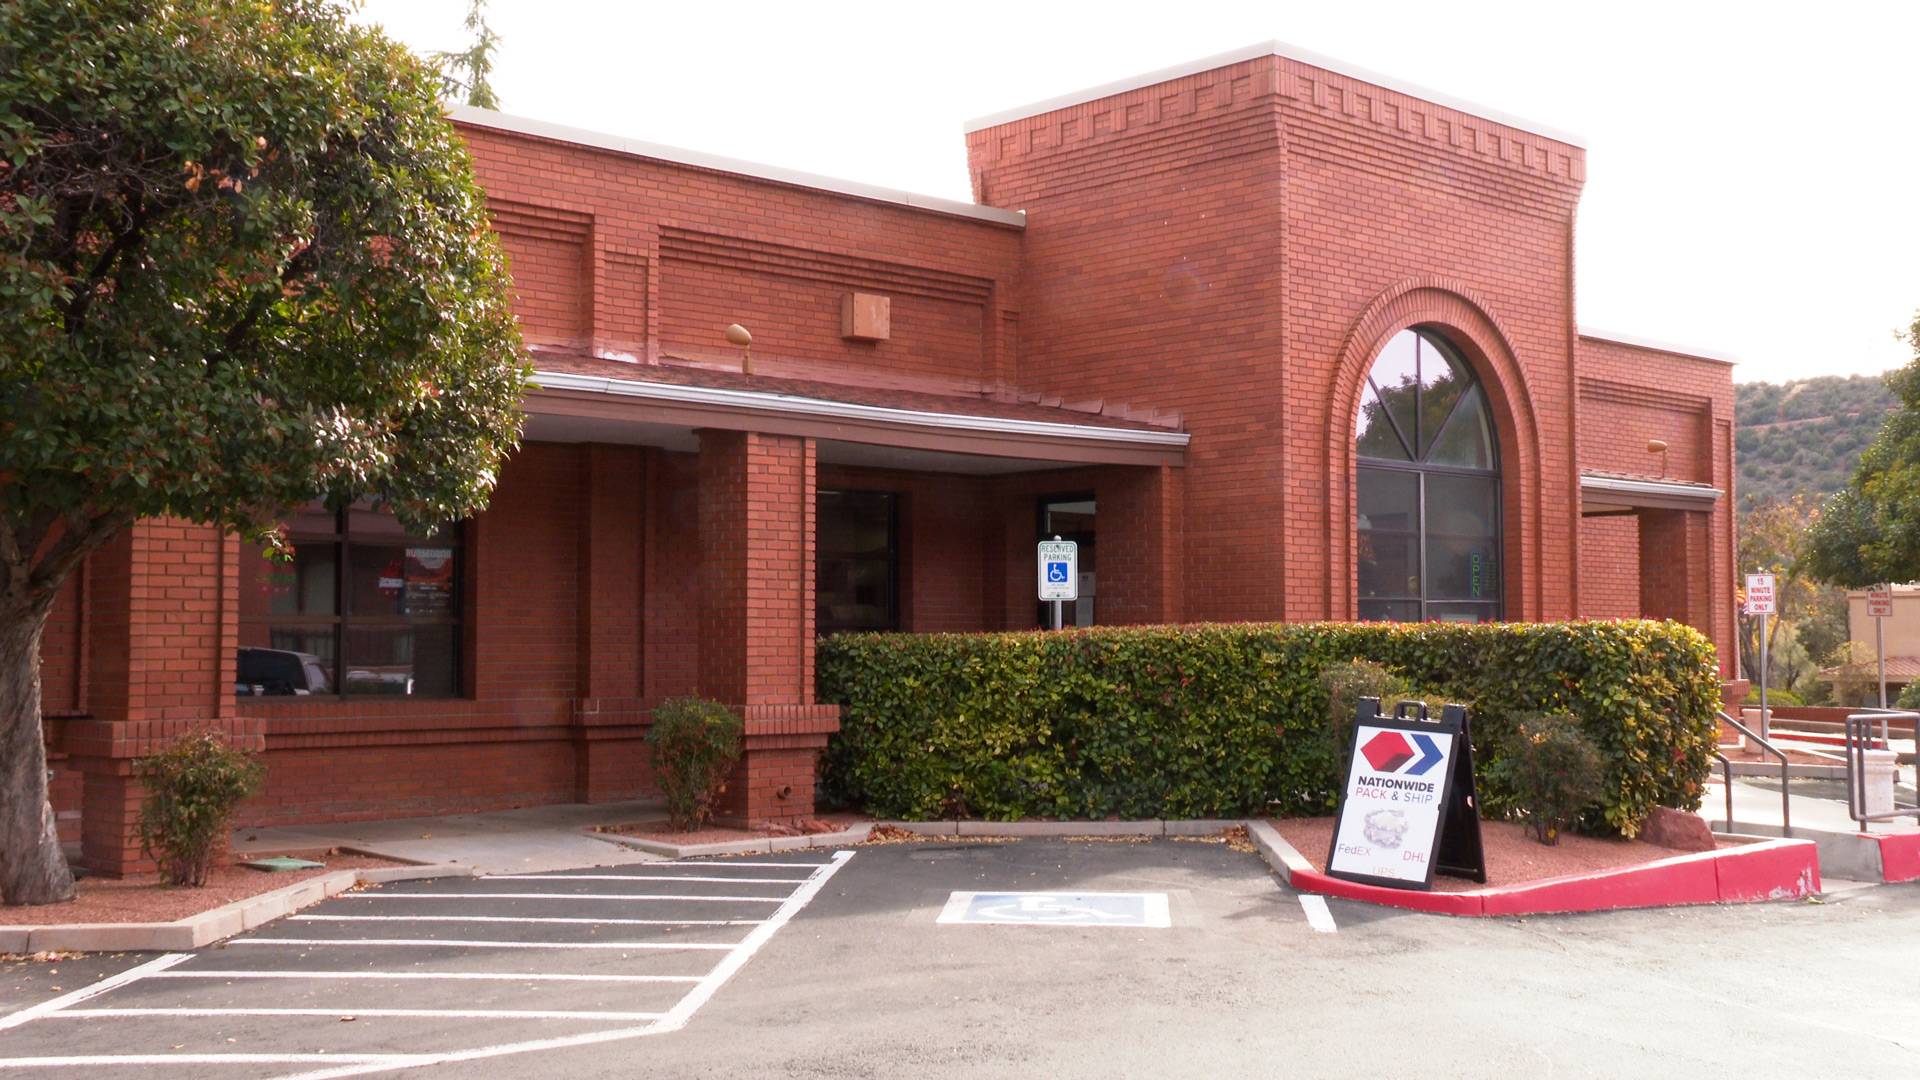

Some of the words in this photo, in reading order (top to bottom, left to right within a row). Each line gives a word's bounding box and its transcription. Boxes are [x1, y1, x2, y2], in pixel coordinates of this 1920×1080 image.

[1041, 545, 1074, 553] RESERVED
[1472, 554, 1480, 596] OPEN
[1358, 776, 1434, 792] NATIONWIDE
[1355, 787, 1387, 799] PACK
[1391, 791, 1399, 801] &
[1403, 792, 1433, 804] SHIP
[1338, 844, 1371, 857] FedEX
[1403, 851, 1426, 863] DHL
[1372, 866, 1395, 877] UPS
